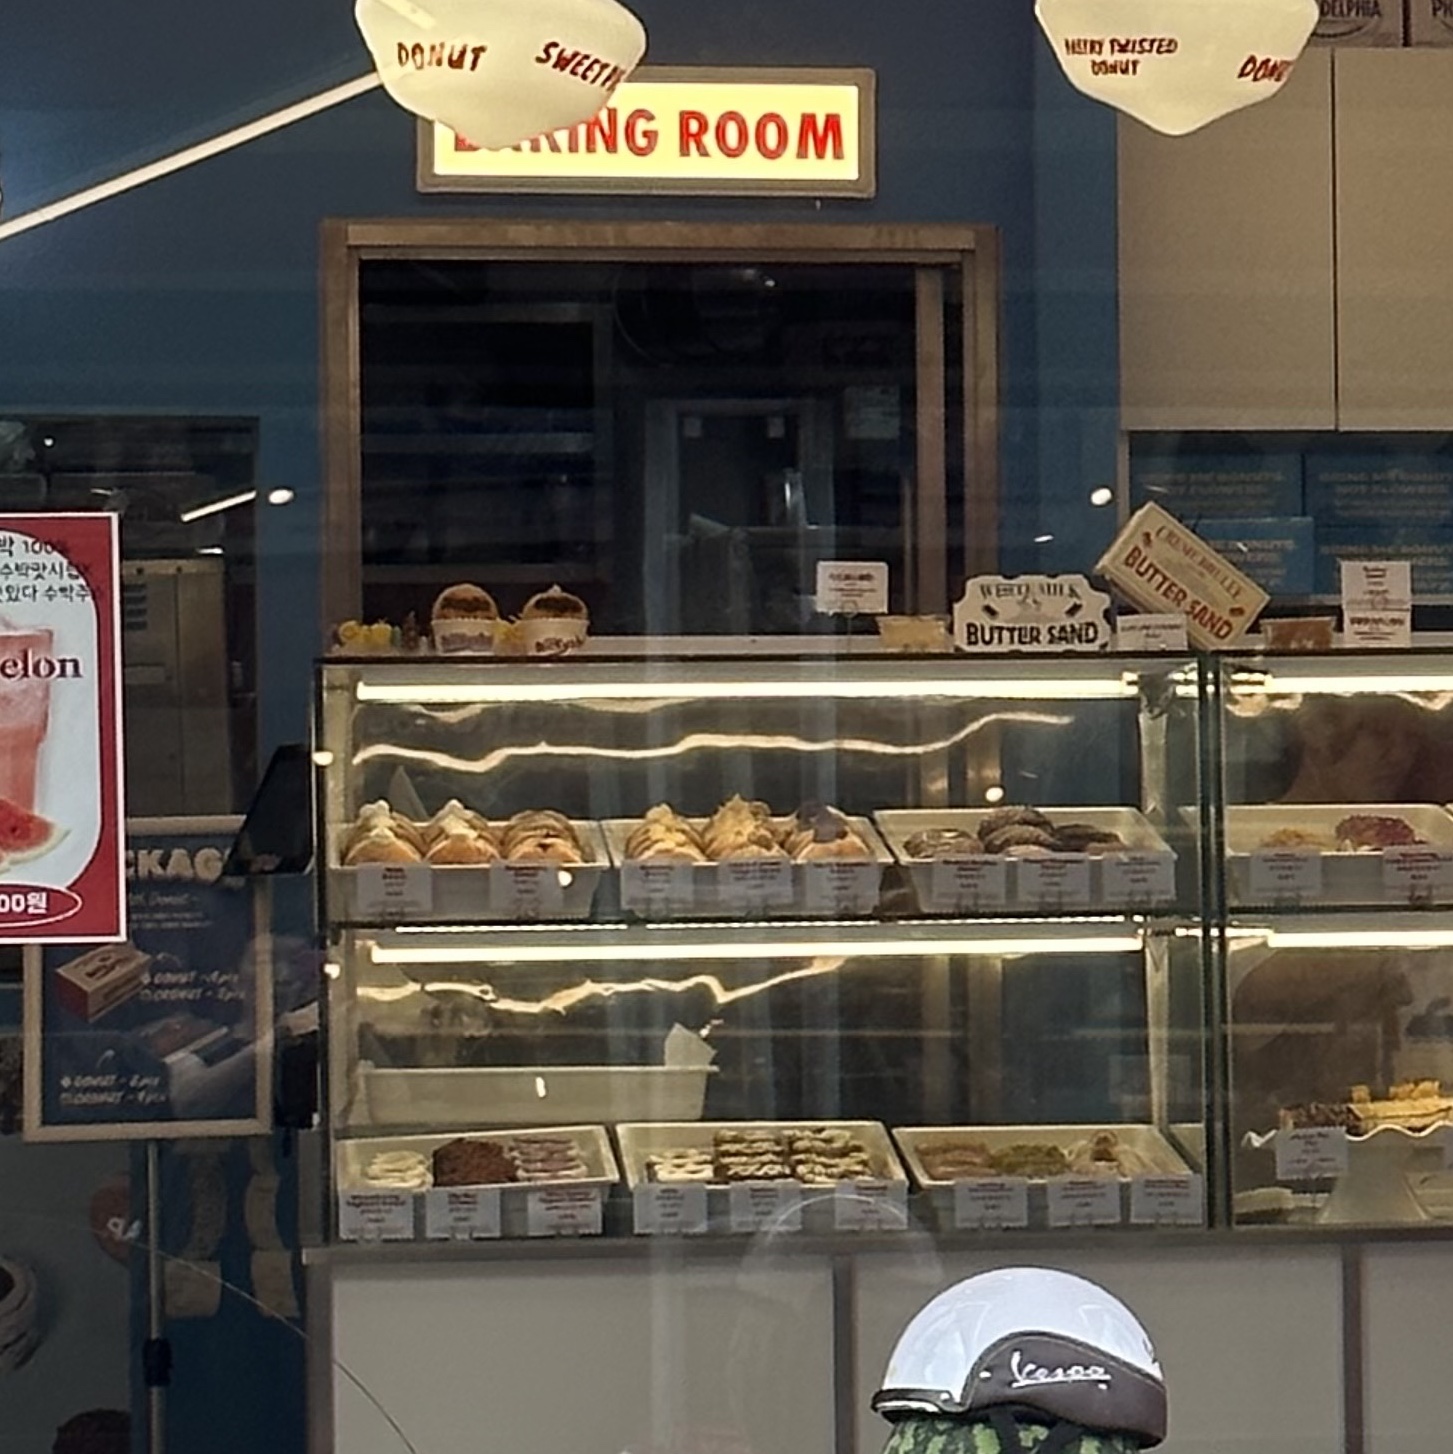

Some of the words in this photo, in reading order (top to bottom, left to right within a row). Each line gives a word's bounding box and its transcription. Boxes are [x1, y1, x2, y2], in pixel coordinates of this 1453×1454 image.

[397, 42, 487, 71] DONUT
[454, 108, 658, 157] ING
[679, 110, 844, 160] ROOM
[1124, 545, 1187, 607] BUTTER
[1185, 599, 1234, 640] SAND
[966, 622, 1041, 646] BUTTER
[1047, 621, 1099, 645] SAND
